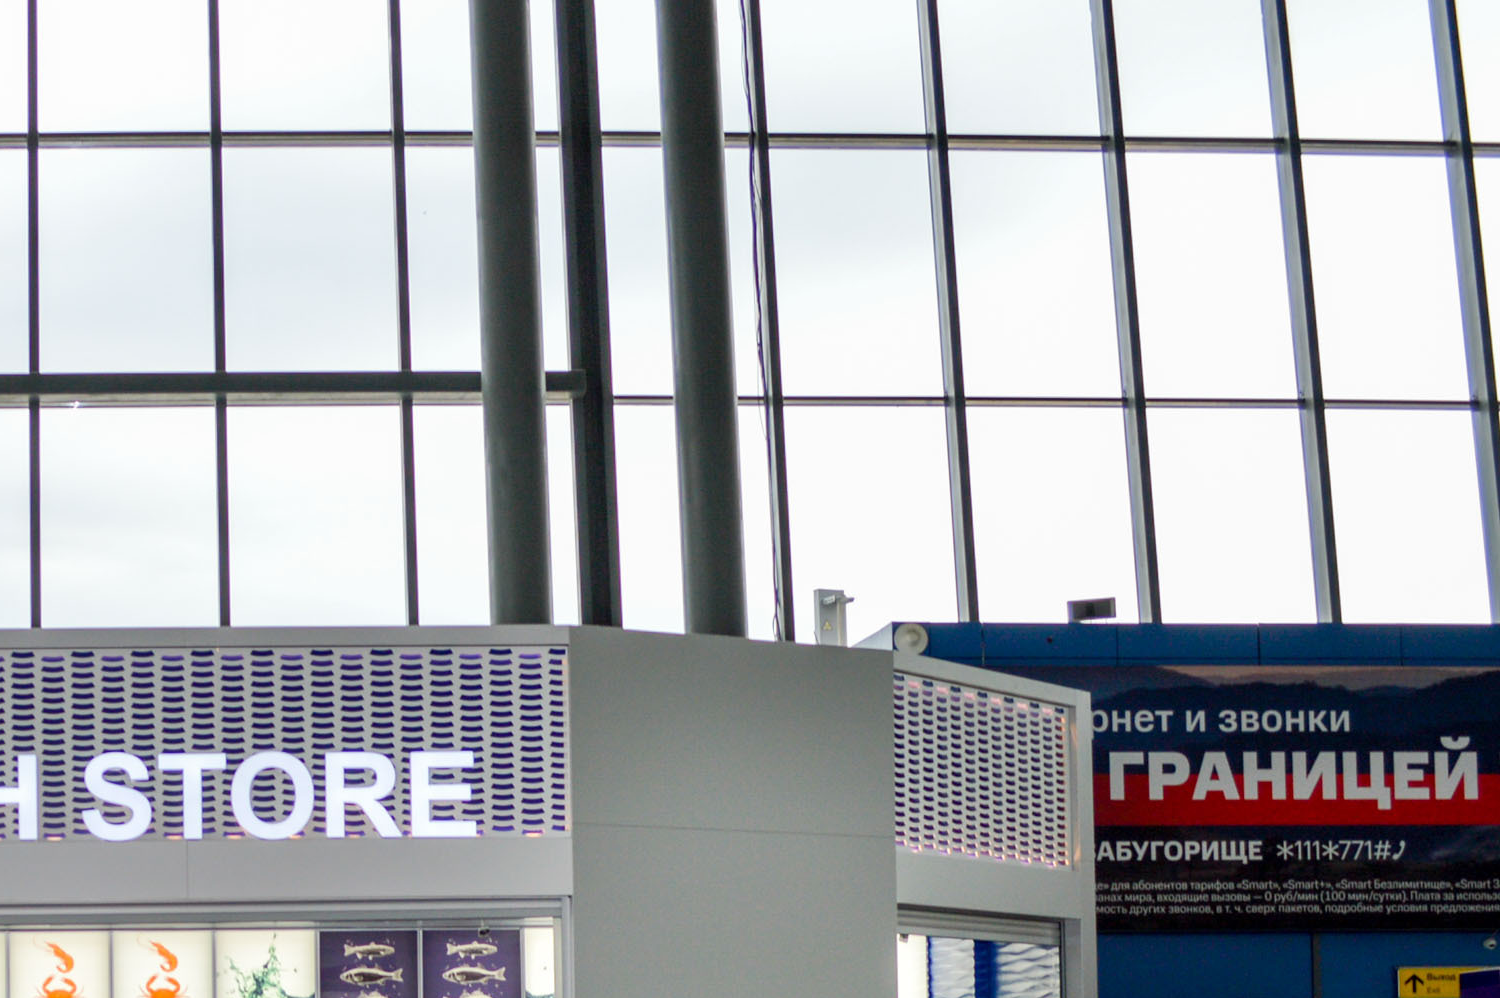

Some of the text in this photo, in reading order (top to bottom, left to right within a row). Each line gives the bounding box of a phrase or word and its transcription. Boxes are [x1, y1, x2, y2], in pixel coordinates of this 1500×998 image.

[1185, 709, 1206, 732] и
[1218, 709, 1351, 733] звонки
[1108, 736, 1479, 810] ГРАНИЦЕЙ
[81, 751, 479, 841] STORE
[1095, 840, 1264, 864] АБУГОРИЩЕ
[1111, 881, 1131, 892] для
[1133, 879, 1188, 891] абонентов
[1190, 880, 1235, 892] тарифов
[1157, 893, 1209, 903] входящие
[1210, 892, 1251, 902] вызовы
[1274, 891, 1319, 903] руб/мин
[1320, 891, 1346, 902] (100
[1410, 891, 1441, 901] Плата
[1442, 893, 1455, 901] за
[1129, 905, 1166, 915] других
[1245, 905, 1276, 915] сверх
[1324, 902, 1384, 914] подробные
[1385, 904, 1428, 914] условия
